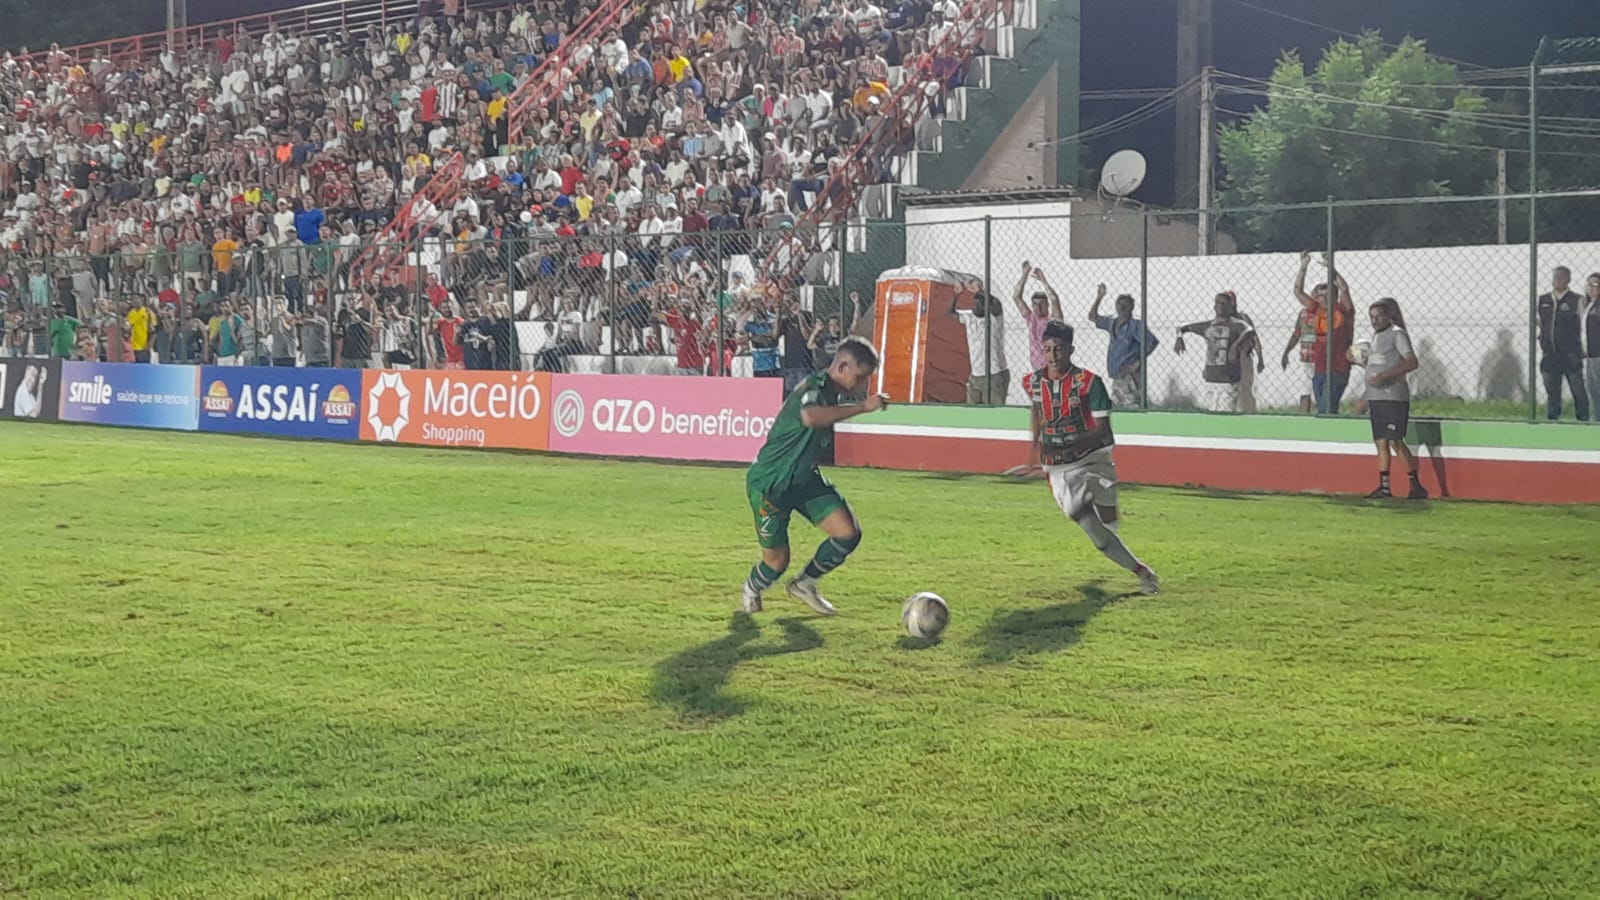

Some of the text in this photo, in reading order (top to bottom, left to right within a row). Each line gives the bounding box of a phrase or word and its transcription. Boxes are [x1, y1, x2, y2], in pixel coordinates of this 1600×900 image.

[68, 374, 113, 405] smile
[423, 374, 541, 420] Maceió
[591, 398, 656, 434] azo
[422, 422, 485, 447] Shopping
